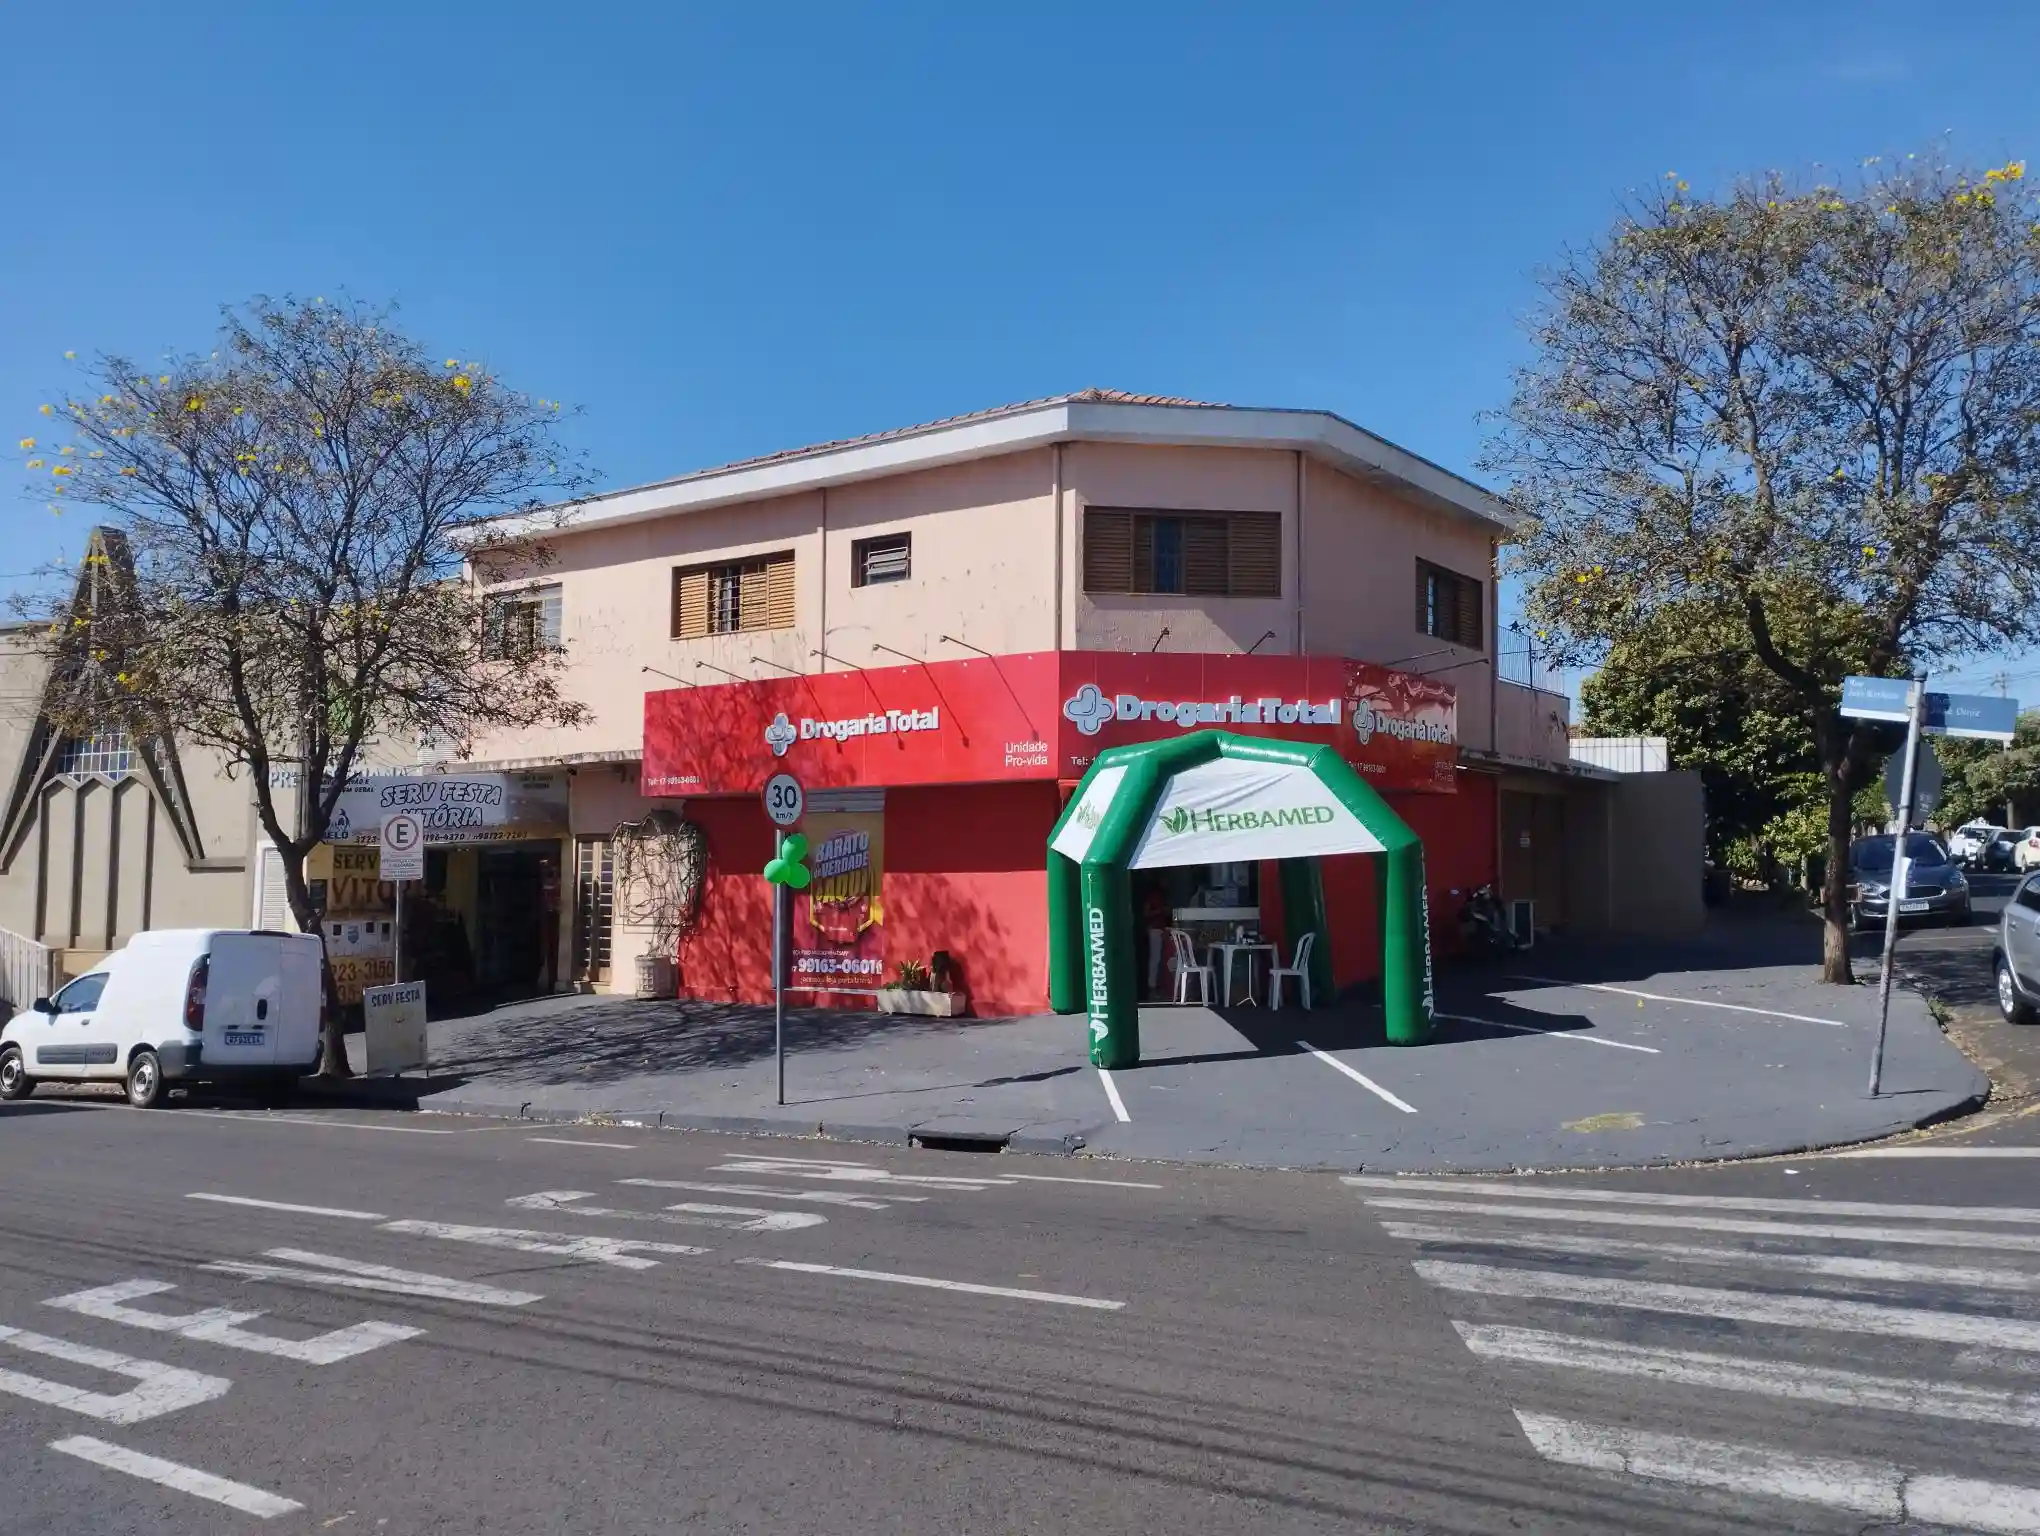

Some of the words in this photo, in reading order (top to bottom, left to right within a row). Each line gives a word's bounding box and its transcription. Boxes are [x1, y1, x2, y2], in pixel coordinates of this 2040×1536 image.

[1116, 694, 1341, 727] DrogariaTotal
[801, 706, 939, 741] DrogariaTotal
[1376, 711, 1452, 745] DrogariaTotal
[1005, 741, 1048, 754] Unidade
[1005, 754, 1048, 767] Pro-vida
[1070, 756, 1089, 766] Tel:
[381, 783, 436, 807] SERV
[441, 781, 502, 806] FESTA
[773, 784, 797, 808] 30
[402, 803, 483, 828] TÓRIA
[776, 811, 794, 819] km/h
[1190, 806, 1335, 832] HERBAMED
[397, 824, 408, 843] E
[815, 832, 869, 863] BARATO
[821, 850, 869, 877] VERDADE
[1089, 907, 1108, 1019] HERBAMED
[396, 989, 420, 1004] FESTA
